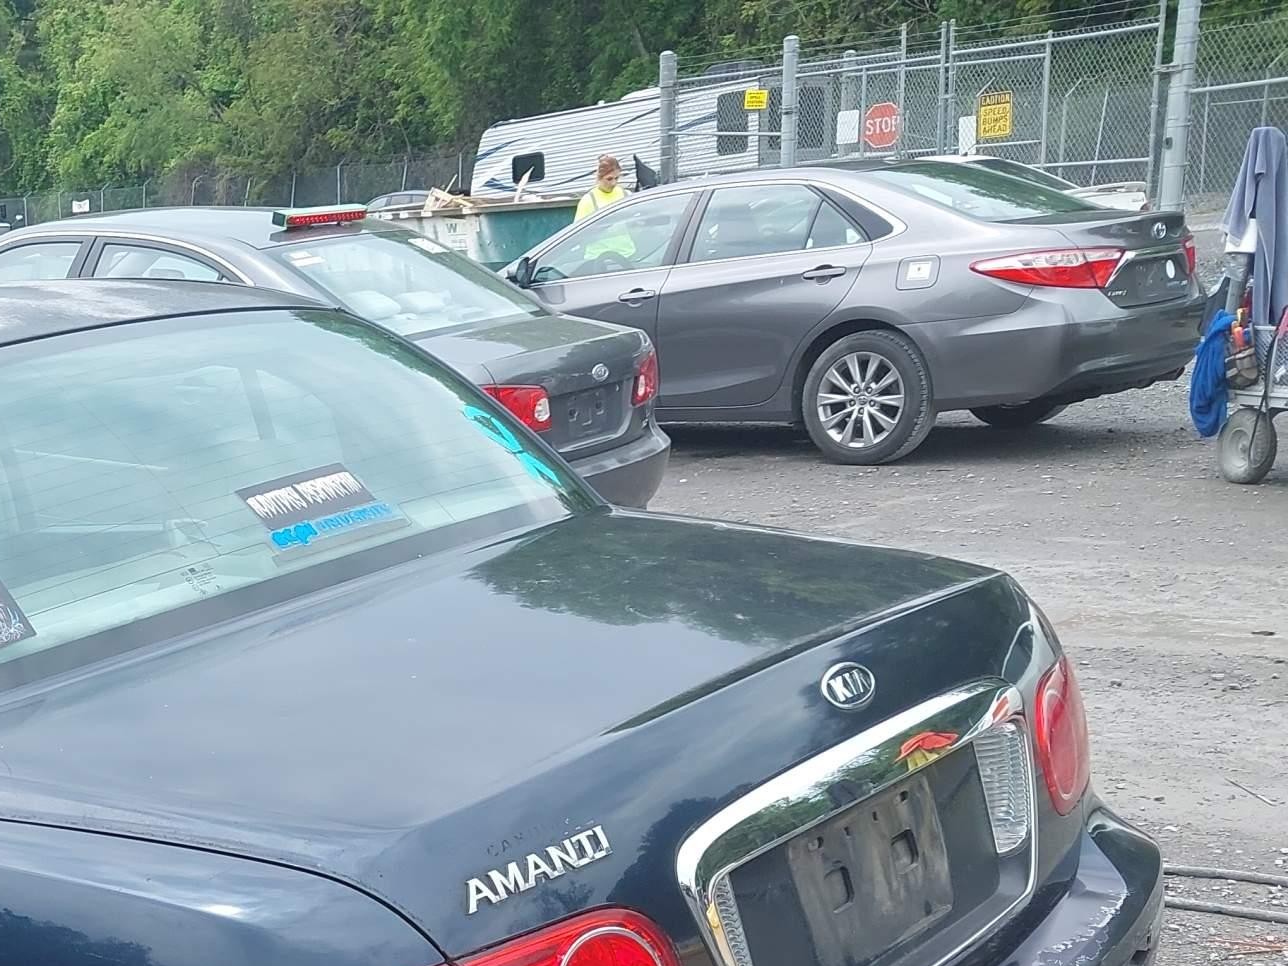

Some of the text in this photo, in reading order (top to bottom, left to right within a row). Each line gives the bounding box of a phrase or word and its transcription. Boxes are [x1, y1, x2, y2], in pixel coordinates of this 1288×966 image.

[983, 107, 1007, 117] SPEED
[983, 114, 1008, 126] BUMPS
[865, 115, 900, 135] STOP
[983, 124, 1007, 134] AHEAD
[828, 669, 871, 702] KIA
[467, 825, 613, 914] AMANTI
